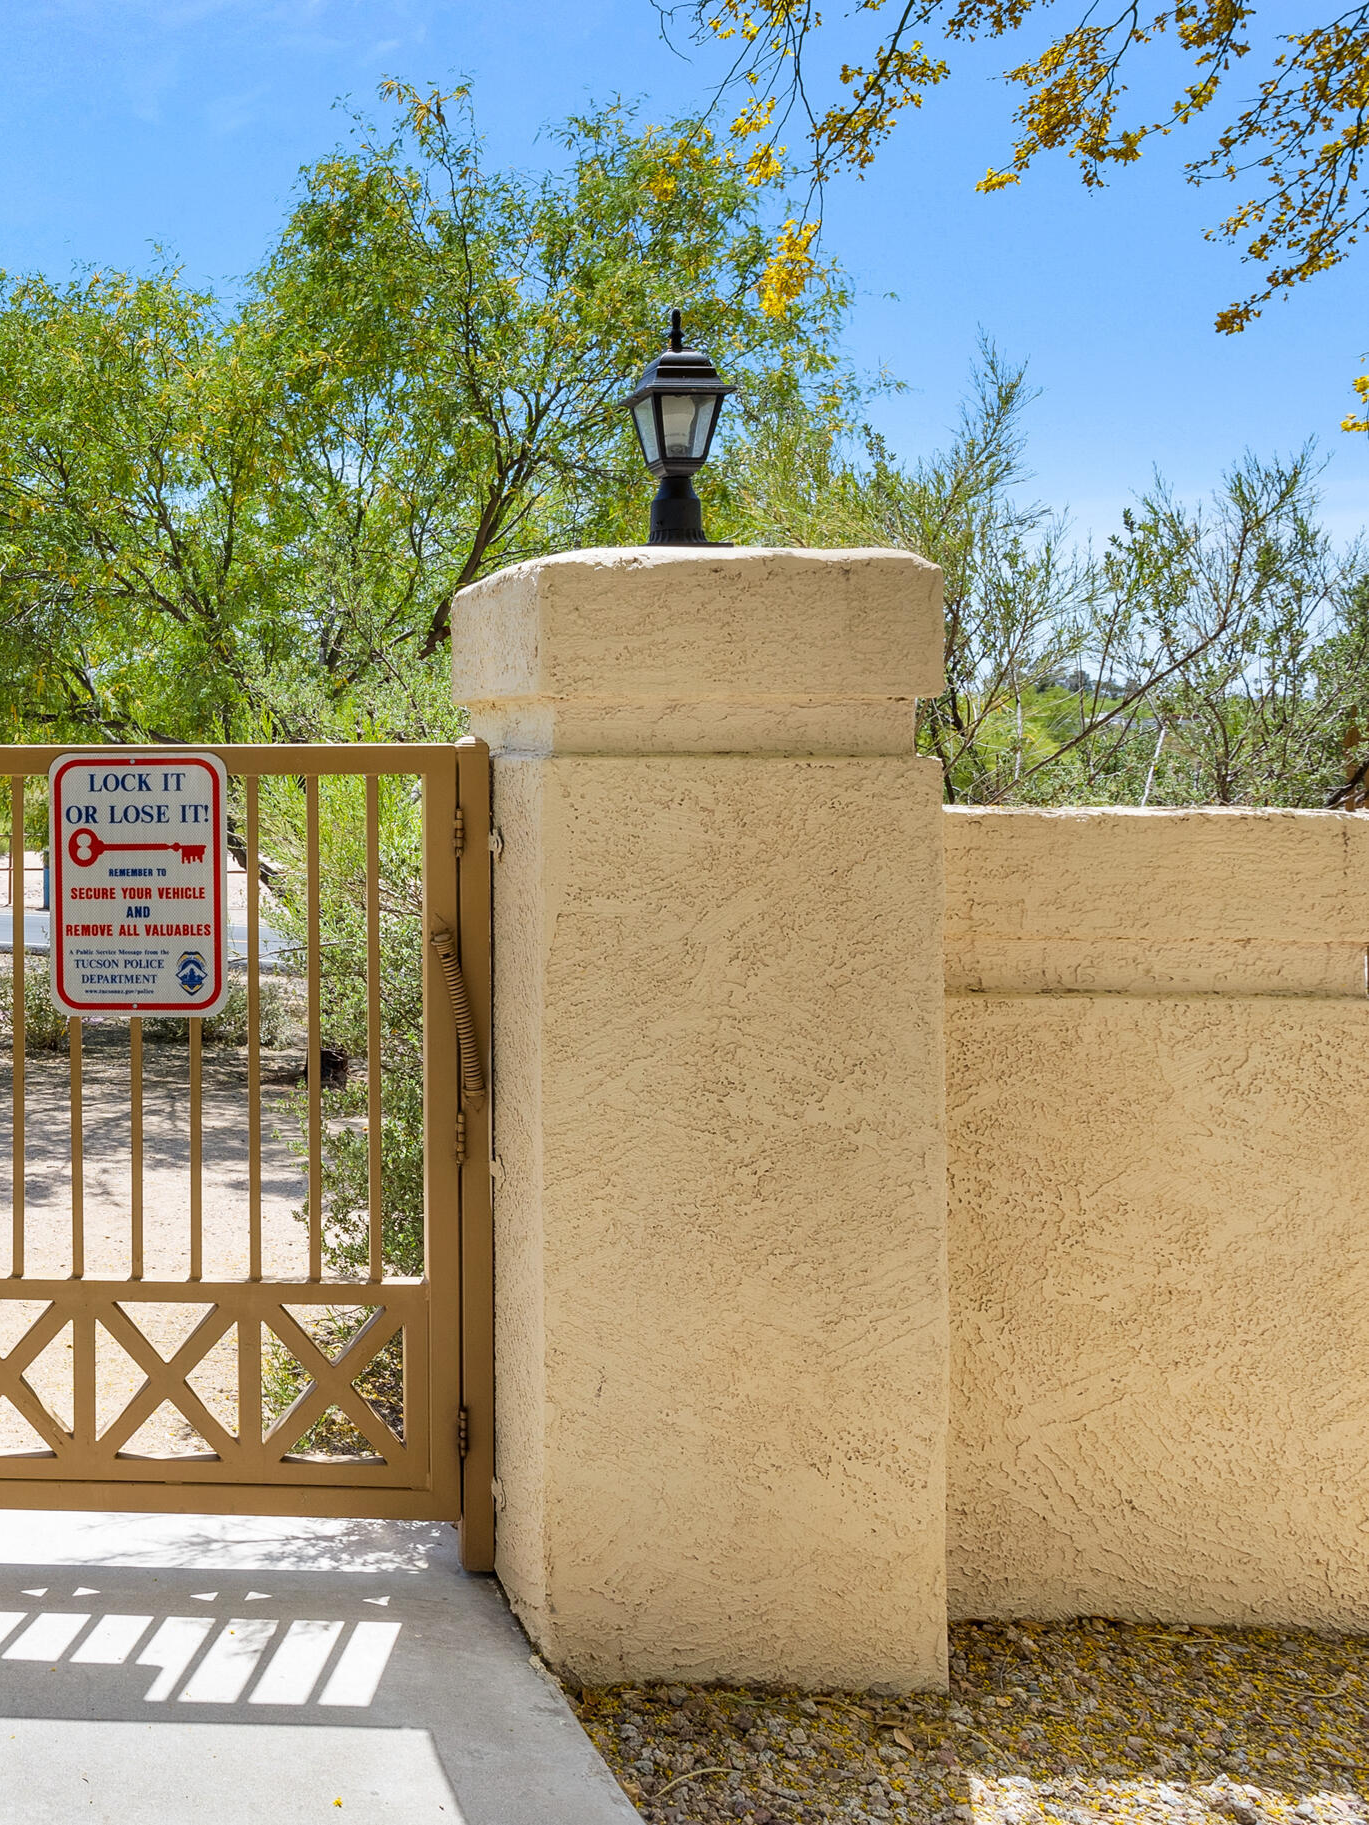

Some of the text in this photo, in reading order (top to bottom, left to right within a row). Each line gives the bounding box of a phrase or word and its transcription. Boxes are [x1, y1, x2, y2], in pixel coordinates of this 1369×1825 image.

[88, 773, 185, 792] LOCK IT
[66, 804, 209, 824] OR LOSE IT!
[71, 888, 205, 899] SECURE YOUR VEHICLE
[126, 907, 150, 918] AND
[66, 925, 211, 936] REMOVE ALL VALUABLES
[75, 960, 164, 968] TUCSON POLICE
[82, 975, 157, 984] DEPARTMENT
